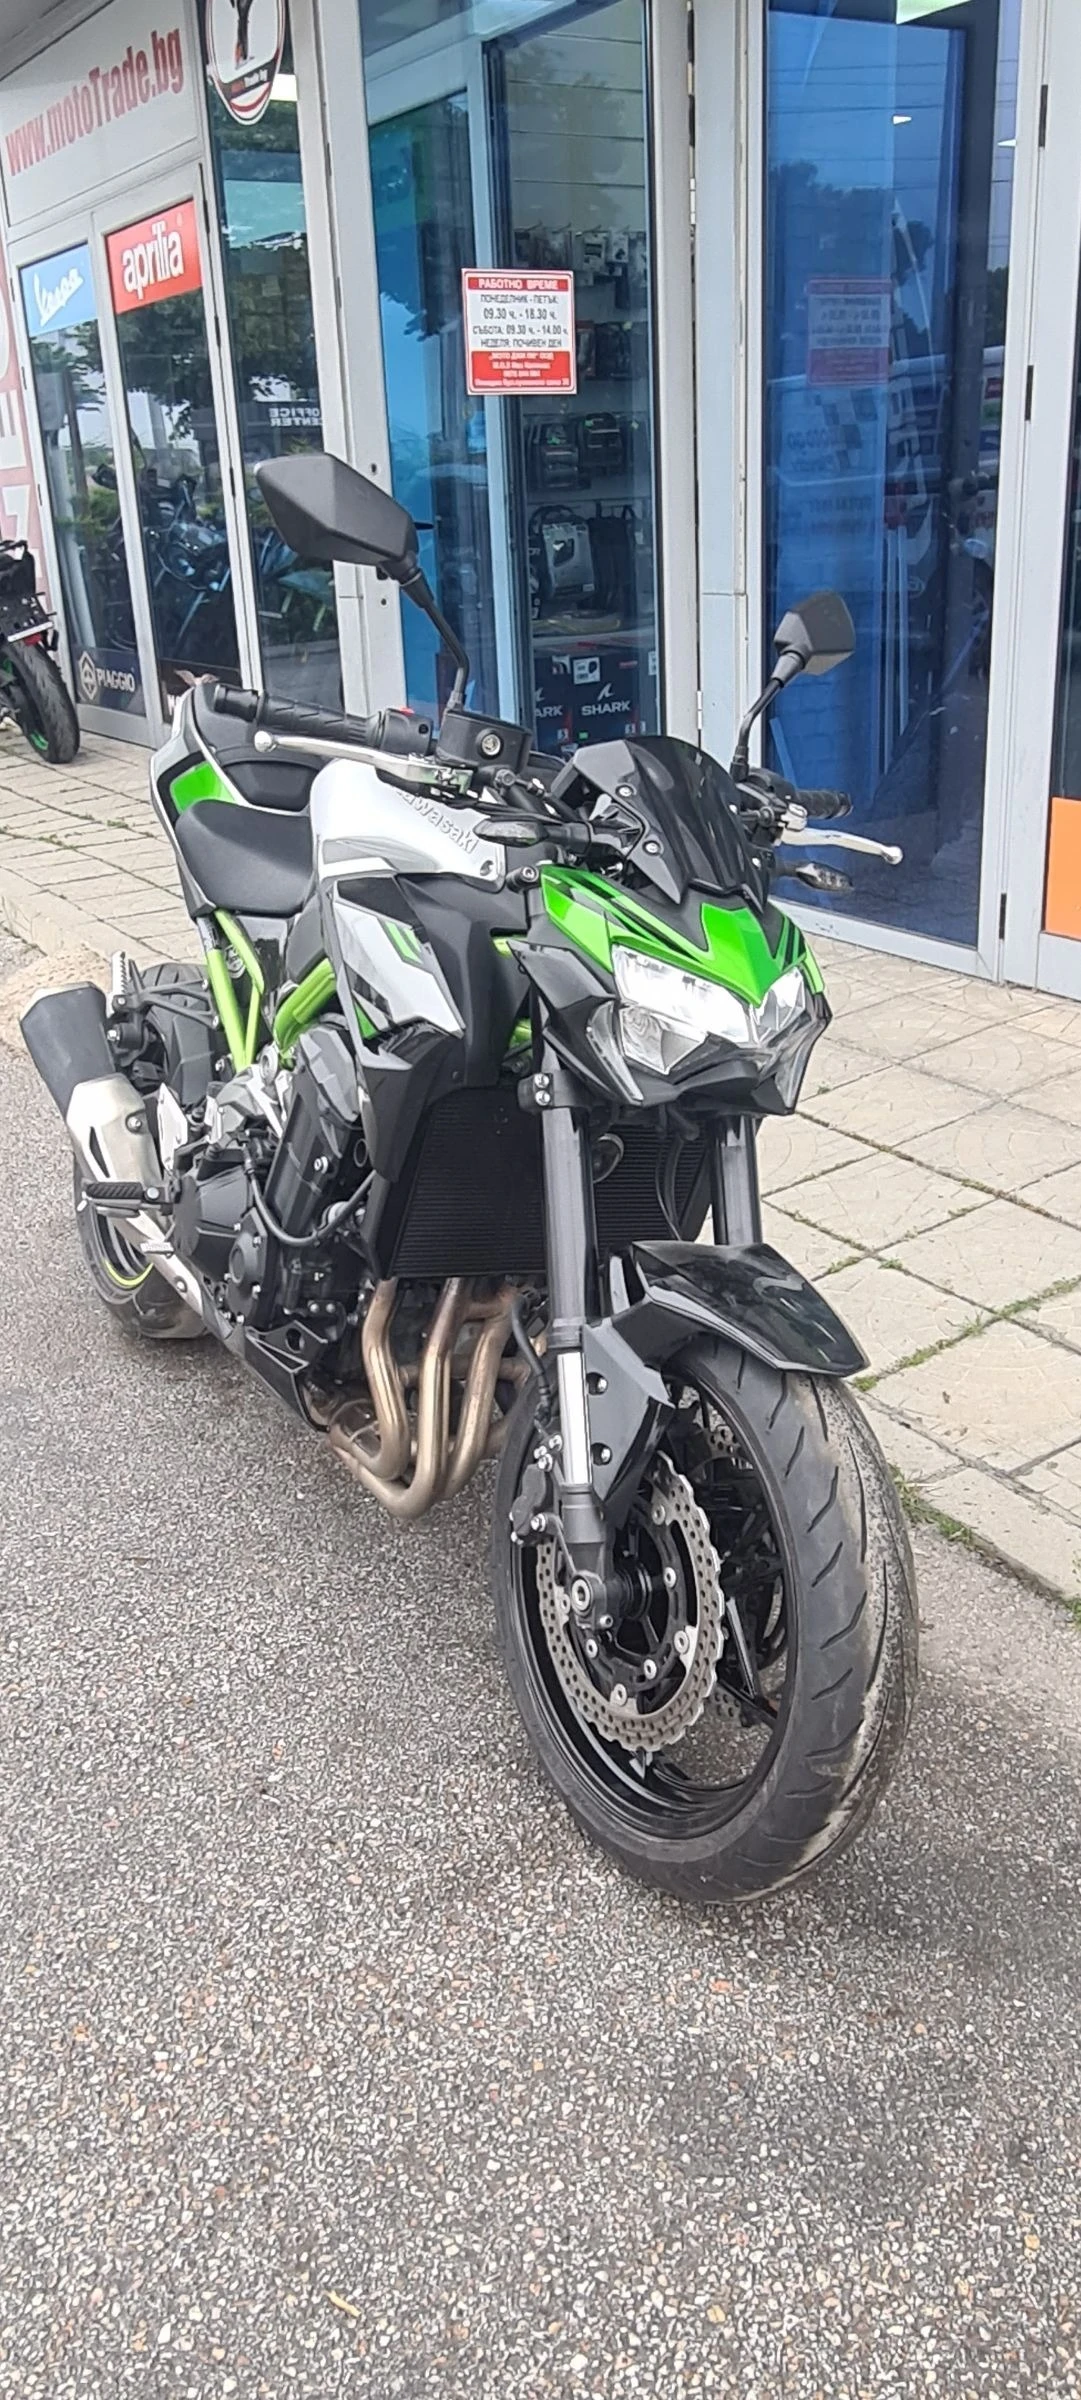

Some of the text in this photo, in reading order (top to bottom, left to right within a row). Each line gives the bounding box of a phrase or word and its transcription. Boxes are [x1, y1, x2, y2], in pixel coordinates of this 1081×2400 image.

[6, 28, 184, 176] www.motoTrade.bg
[122, 220, 184, 299] aprilia
[479, 278, 559, 290] РАБОТНО ВРЕМЕ
[33, 267, 85, 326] Vespa
[483, 308, 507, 319] 09.30
[525, 308, 547, 319] 18.30
[506, 325, 526, 334] 09.30
[96, 668, 135, 693] PIAGGIO
[535, 705, 563, 718] ARK
[581, 700, 631, 716] SHARK
[397, 791, 479, 854] awasaki
